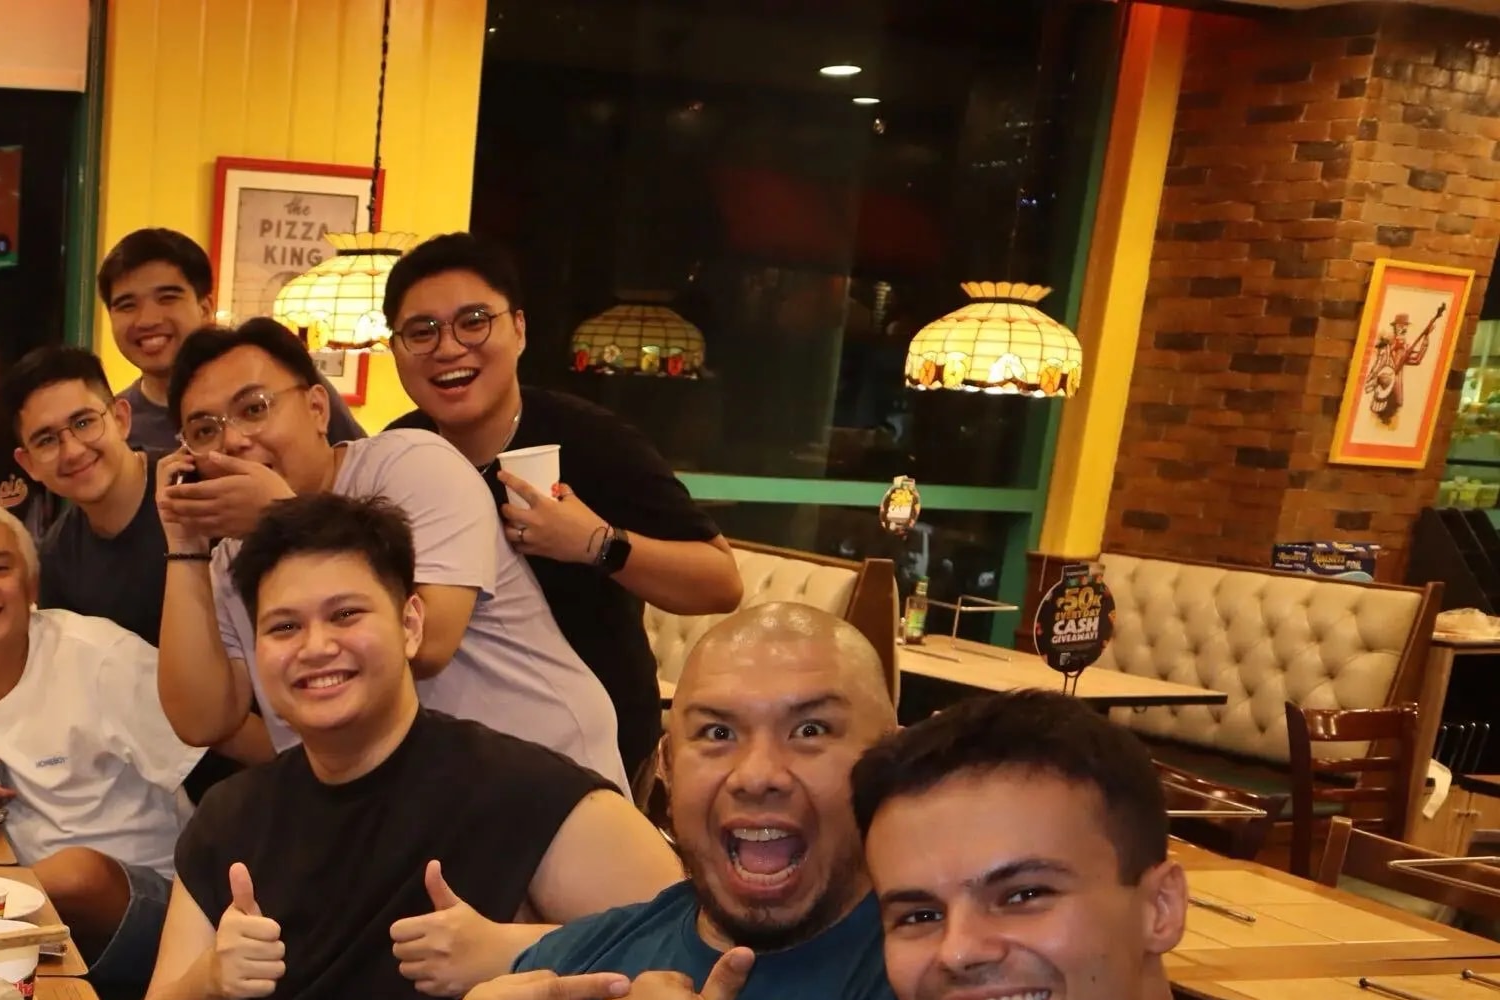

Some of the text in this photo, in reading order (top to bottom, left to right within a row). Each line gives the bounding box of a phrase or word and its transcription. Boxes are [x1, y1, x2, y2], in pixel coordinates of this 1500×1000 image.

[284, 196, 311, 217] the
[259, 218, 330, 242] PIZZA
[262, 245, 323, 267] KING
[1053, 617, 1099, 635] CASH
